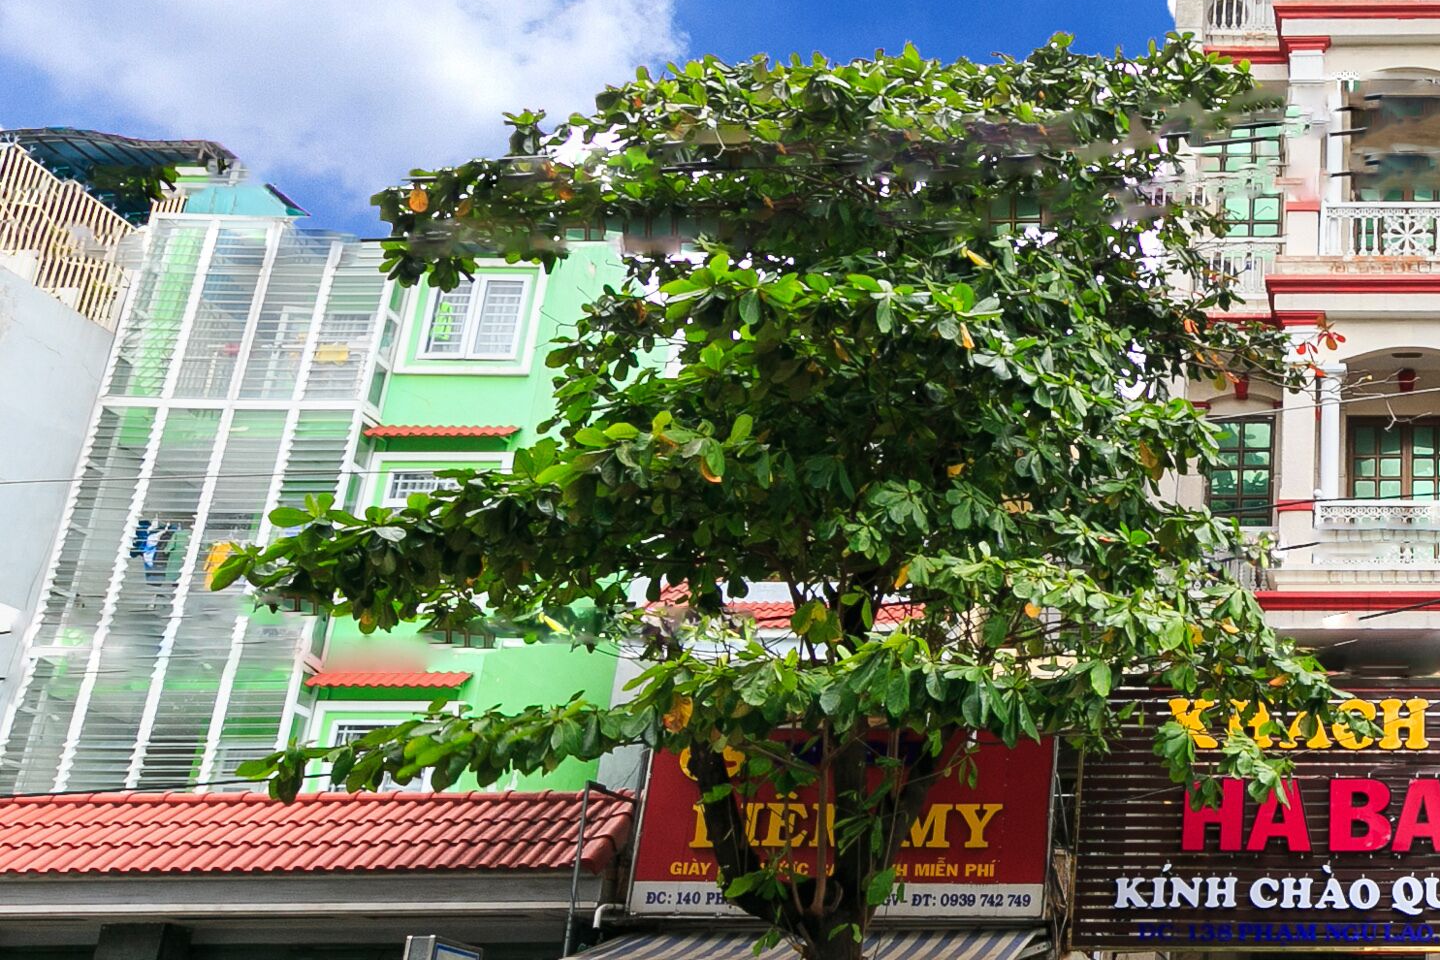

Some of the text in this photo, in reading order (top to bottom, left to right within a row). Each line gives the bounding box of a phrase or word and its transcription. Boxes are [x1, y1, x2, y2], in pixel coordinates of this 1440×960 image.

[901, 803, 1004, 848] MY
[670, 858, 712, 876] GIÀY
[914, 857, 958, 877] MIỄN
[964, 860, 996, 877] PHÍ
[1114, 863, 1238, 909] KÍNH
[1250, 863, 1381, 910] CHÀO
[645, 891, 672, 905] ĐC:
[676, 891, 701, 905] 140
[911, 894, 936, 907] ĐT:
[940, 894, 976, 907] 0939
[981, 893, 1004, 907] 742
[1007, 894, 1031, 907] 749
